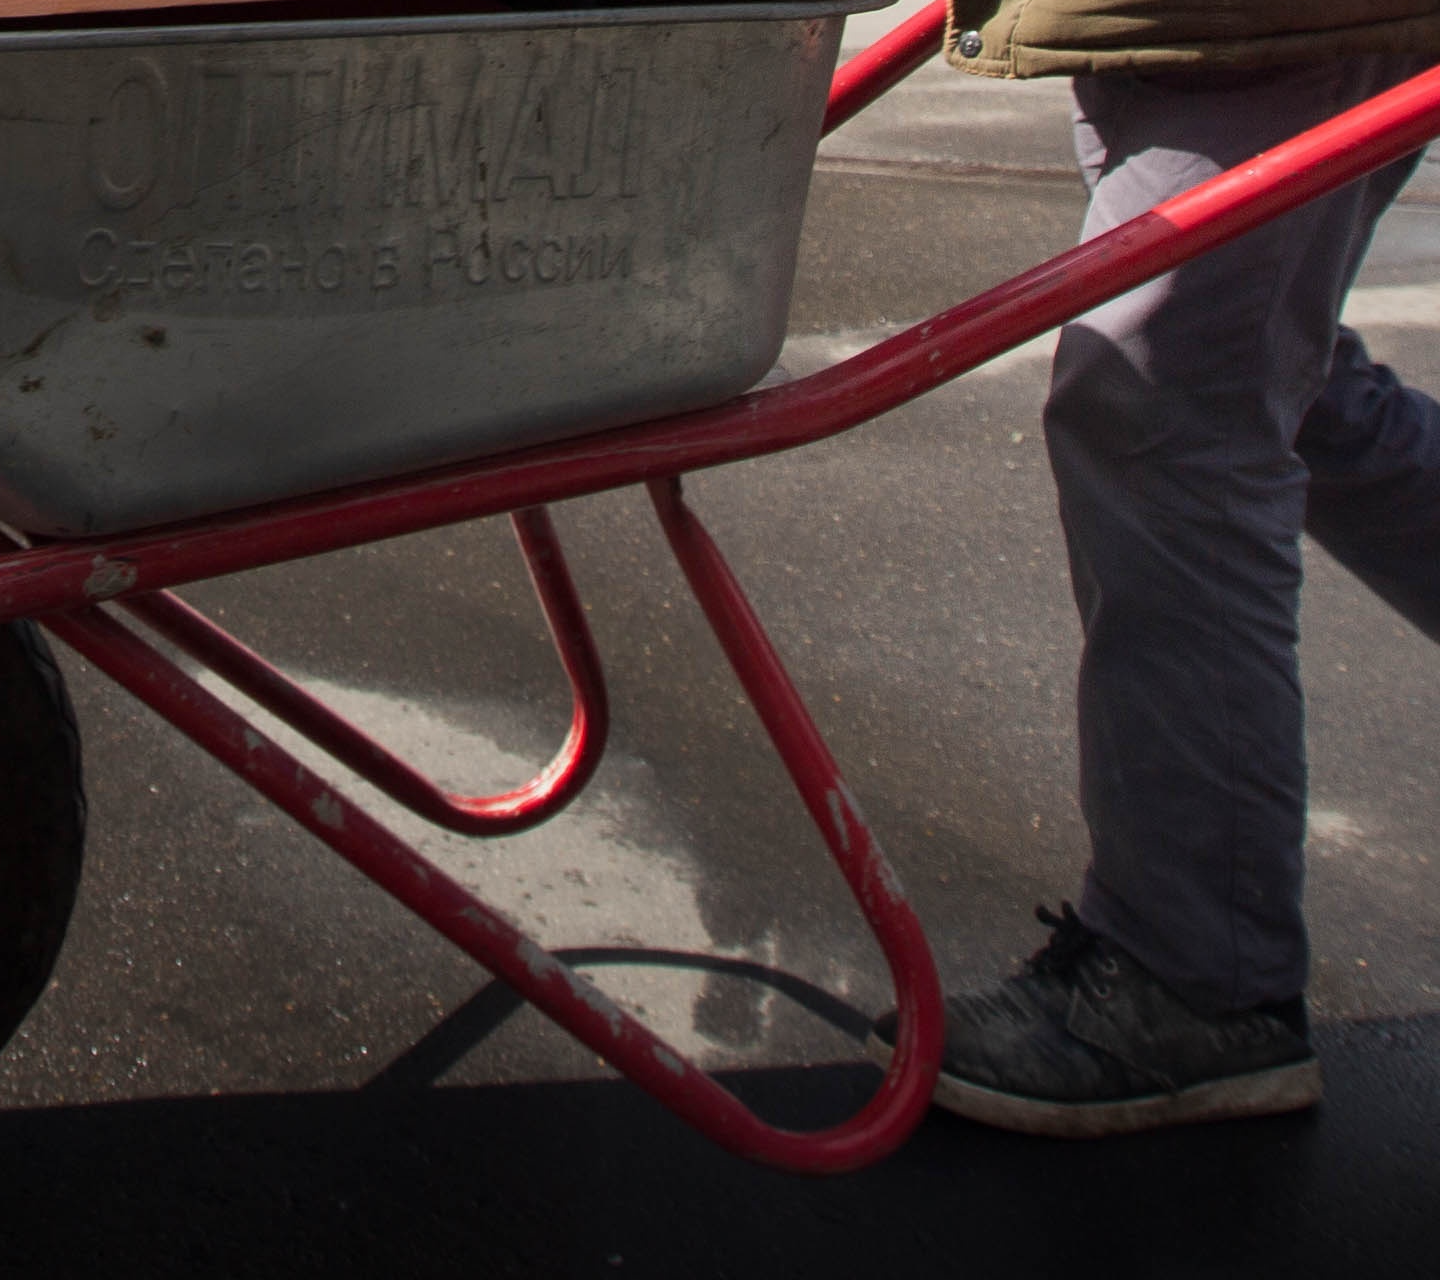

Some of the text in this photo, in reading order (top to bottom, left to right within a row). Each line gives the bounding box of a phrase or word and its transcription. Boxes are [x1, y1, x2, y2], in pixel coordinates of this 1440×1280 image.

[77, 227, 633, 293] Сделано в России
